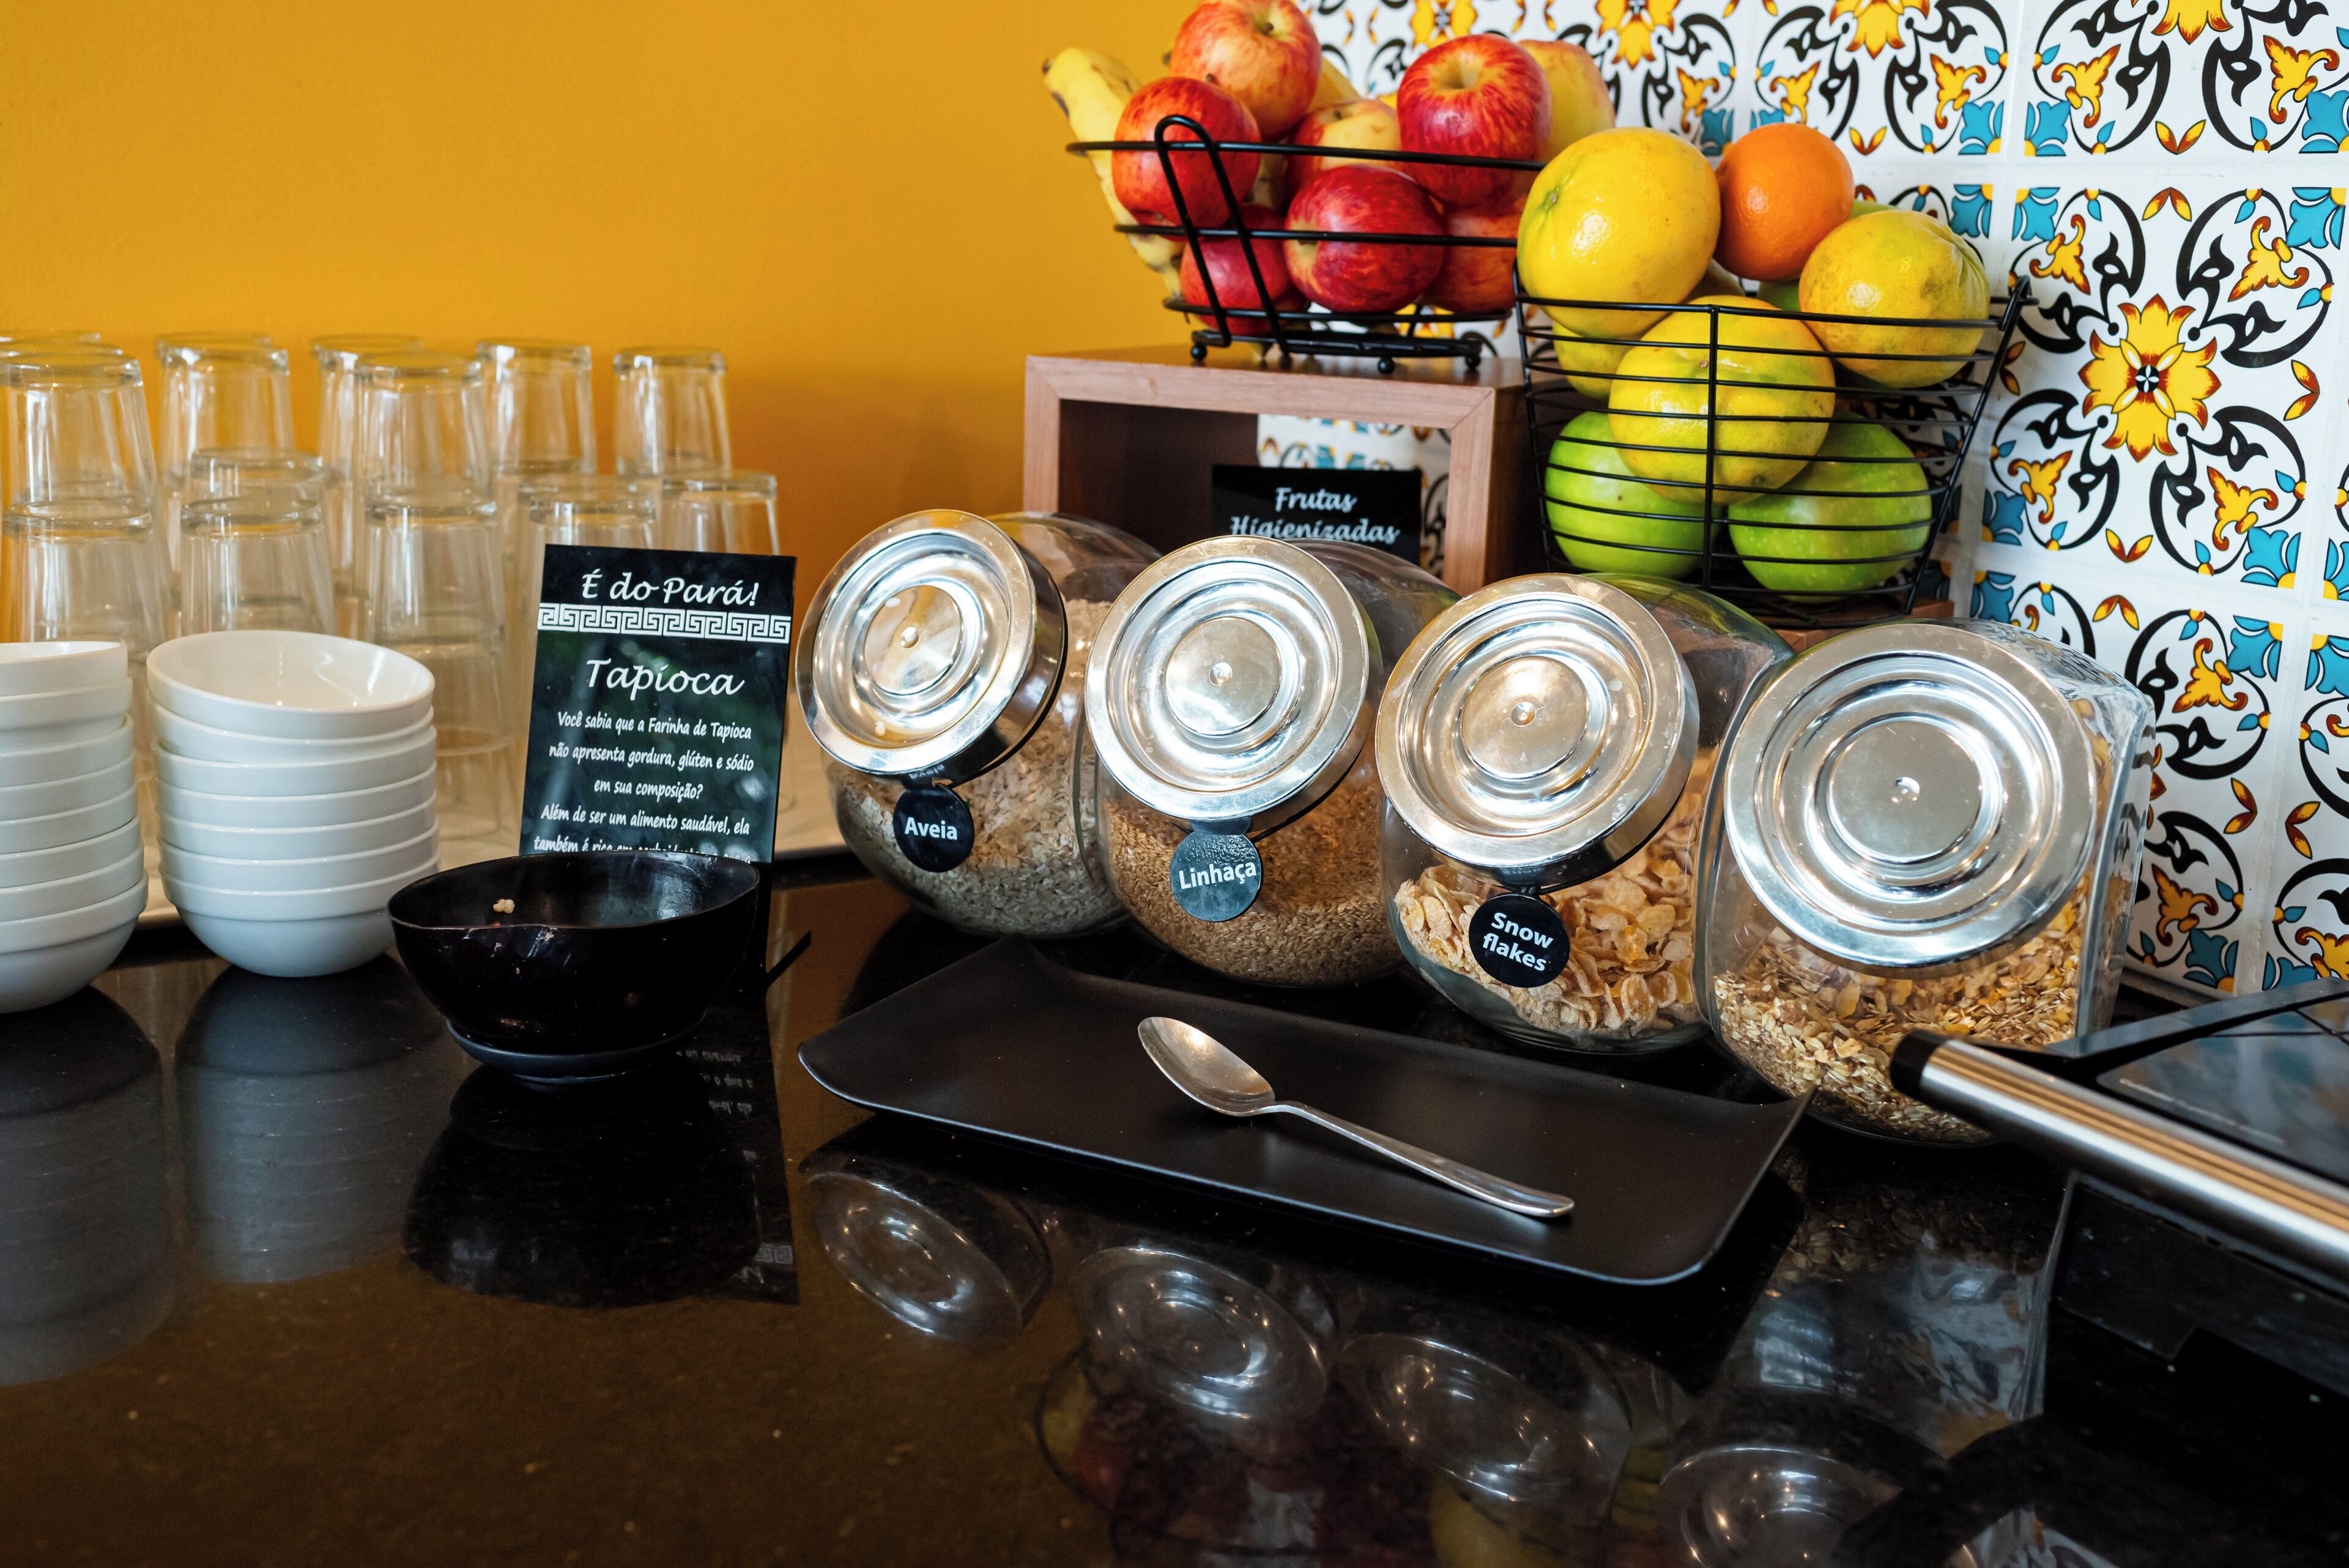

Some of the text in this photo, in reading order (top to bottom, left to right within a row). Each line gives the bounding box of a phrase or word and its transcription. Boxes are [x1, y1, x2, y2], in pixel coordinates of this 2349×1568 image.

[1275, 487, 1358, 513] Frutas
[1230, 515, 1401, 544] Higienizadas
[582, 568, 760, 606] É do Pará!
[586, 658, 746, 700] Tapioca
[557, 710, 752, 744] Você sabia que a Farinha de Tapioca
[549, 741, 754, 772] não apresenta gordura, glúten e sódio
[593, 779, 703, 803] em sua composição?
[540, 803, 750, 836] Além de ser um alimento saudável, ela
[904, 816, 958, 841] Aveia
[533, 834, 579, 852] também
[582, 838, 590, 852] é
[1178, 860, 1257, 890] Linhaça
[1491, 912, 1554, 949] Snow
[1482, 932, 1547, 972] flakes
